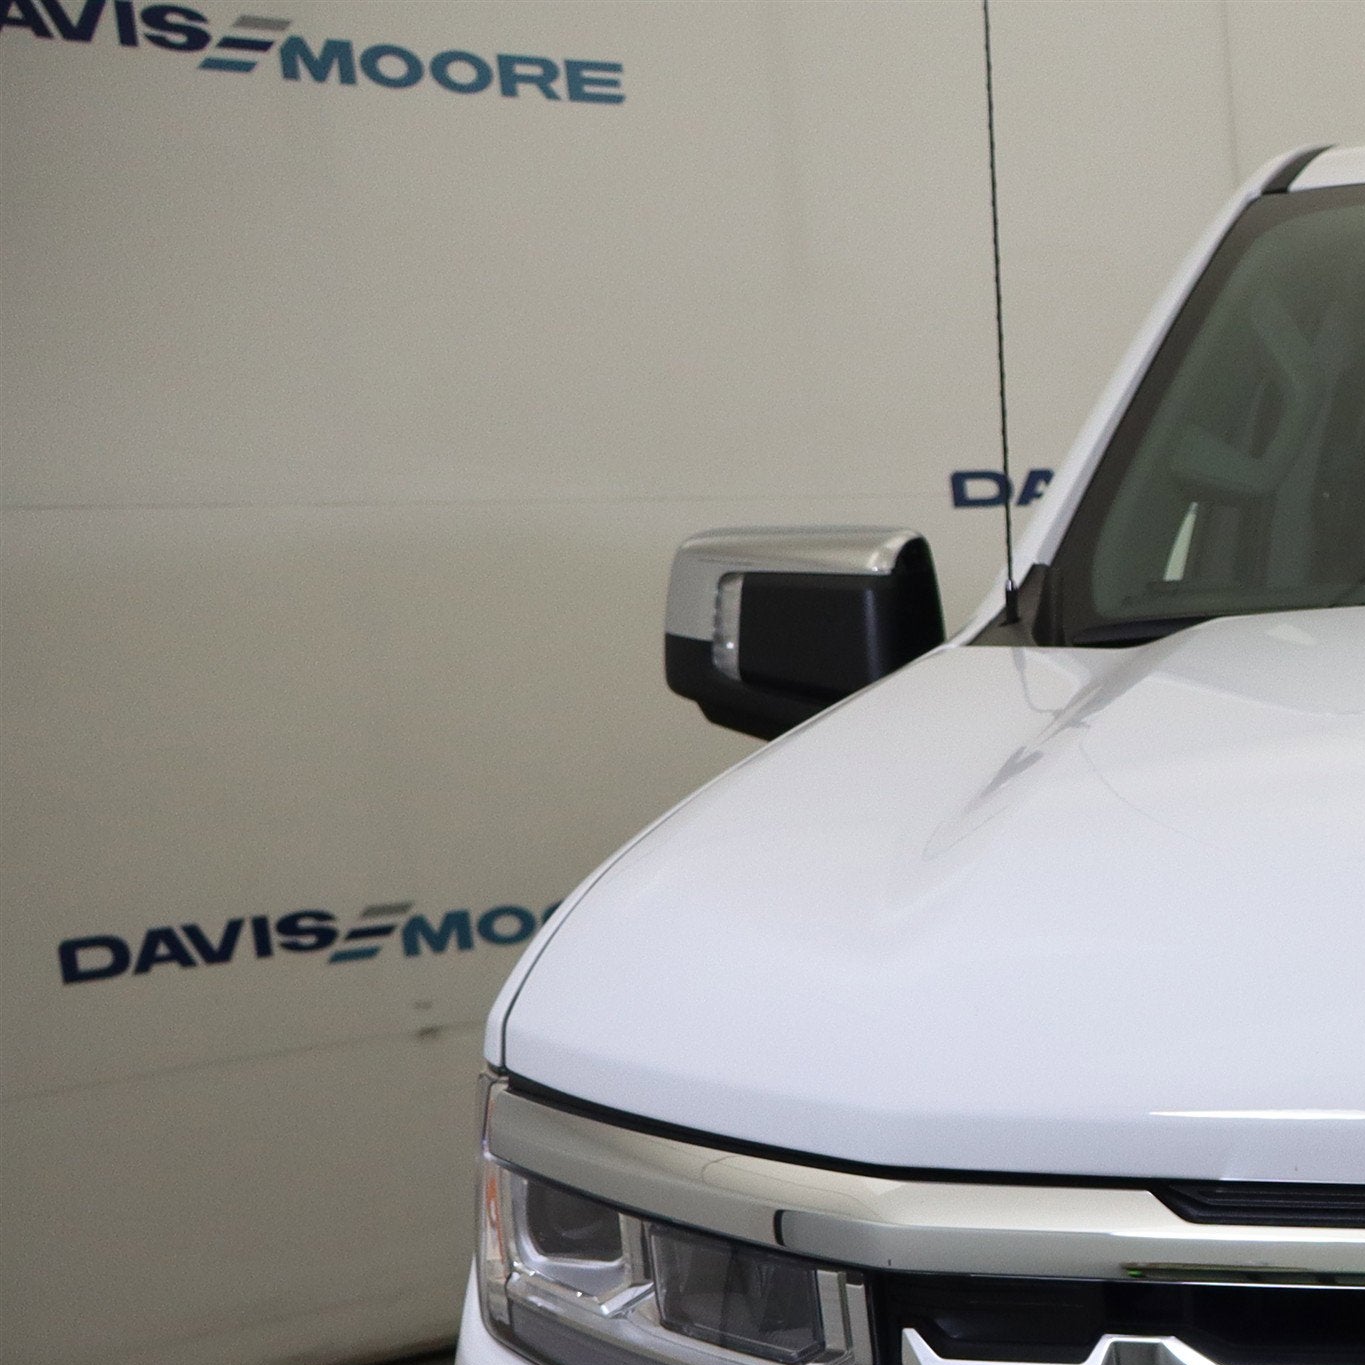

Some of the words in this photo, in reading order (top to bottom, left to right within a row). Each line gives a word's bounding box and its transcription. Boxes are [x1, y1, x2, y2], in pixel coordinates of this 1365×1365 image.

[280, 34, 625, 106] MOORE
[57, 909, 340, 986] DAVIS
[401, 899, 564, 958] MO
